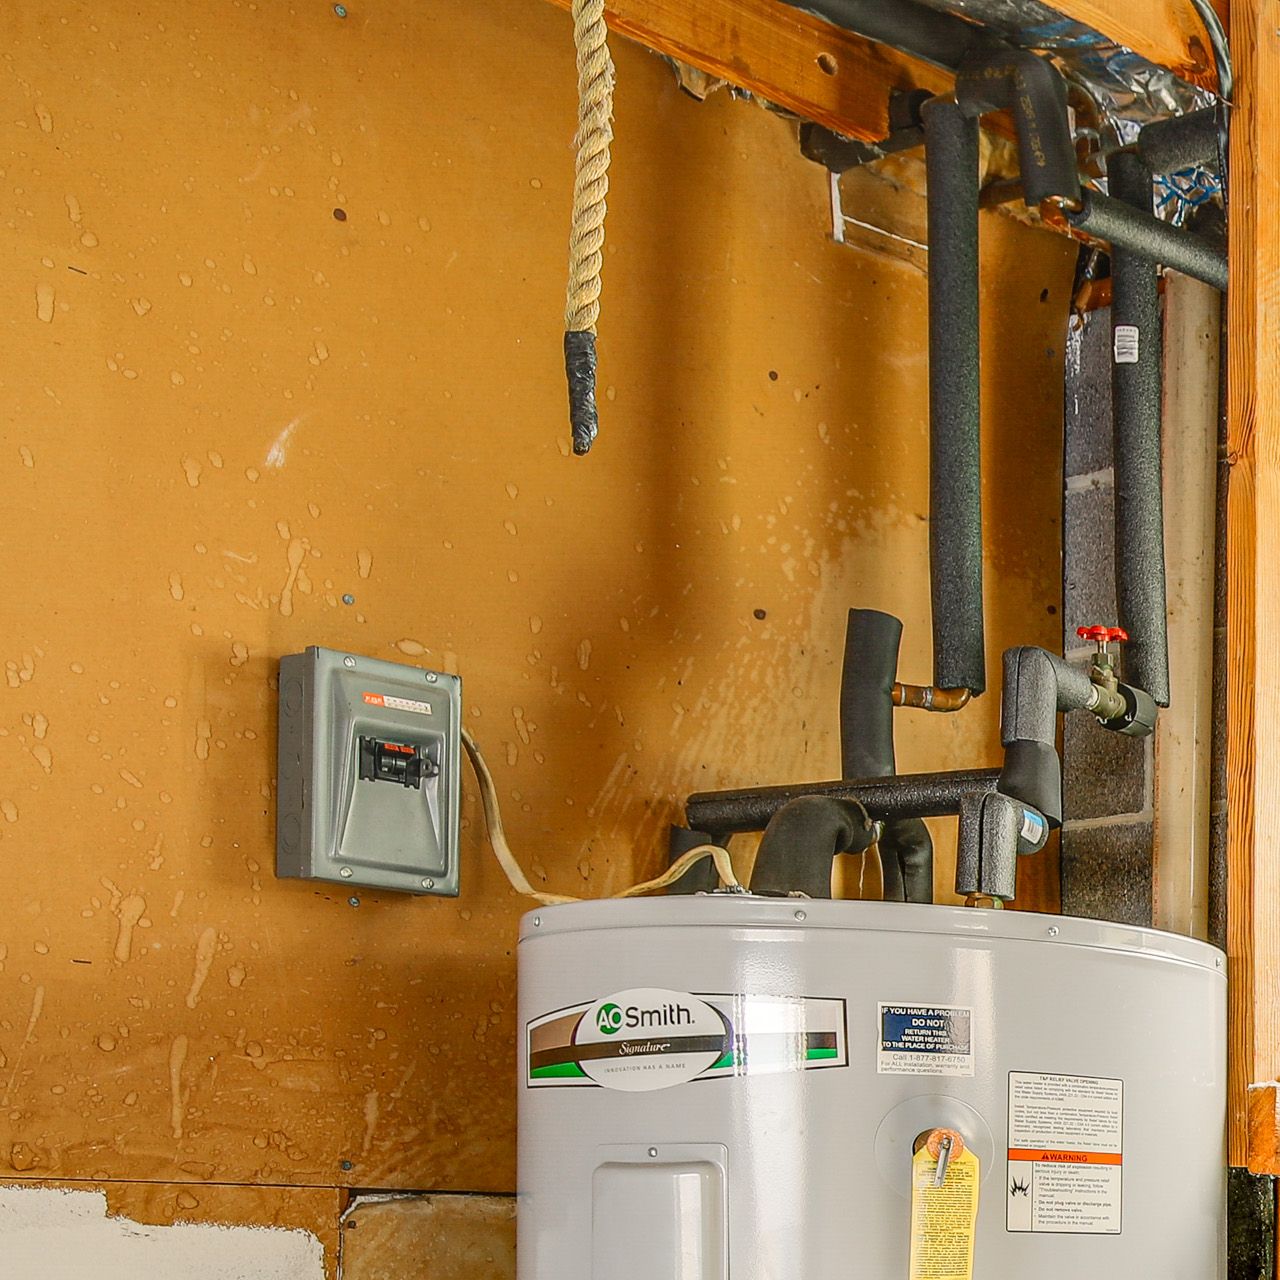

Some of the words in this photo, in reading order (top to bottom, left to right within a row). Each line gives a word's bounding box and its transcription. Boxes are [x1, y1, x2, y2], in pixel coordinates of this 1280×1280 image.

[890, 1007, 907, 1015] YOU
[912, 1019, 926, 1027] DO
[926, 1019, 945, 1027] NOT
[618, 1041, 672, 1055] Signature
[604, 1066, 641, 1074] INNOVATION
[1050, 1154, 1088, 1162] WARNING
